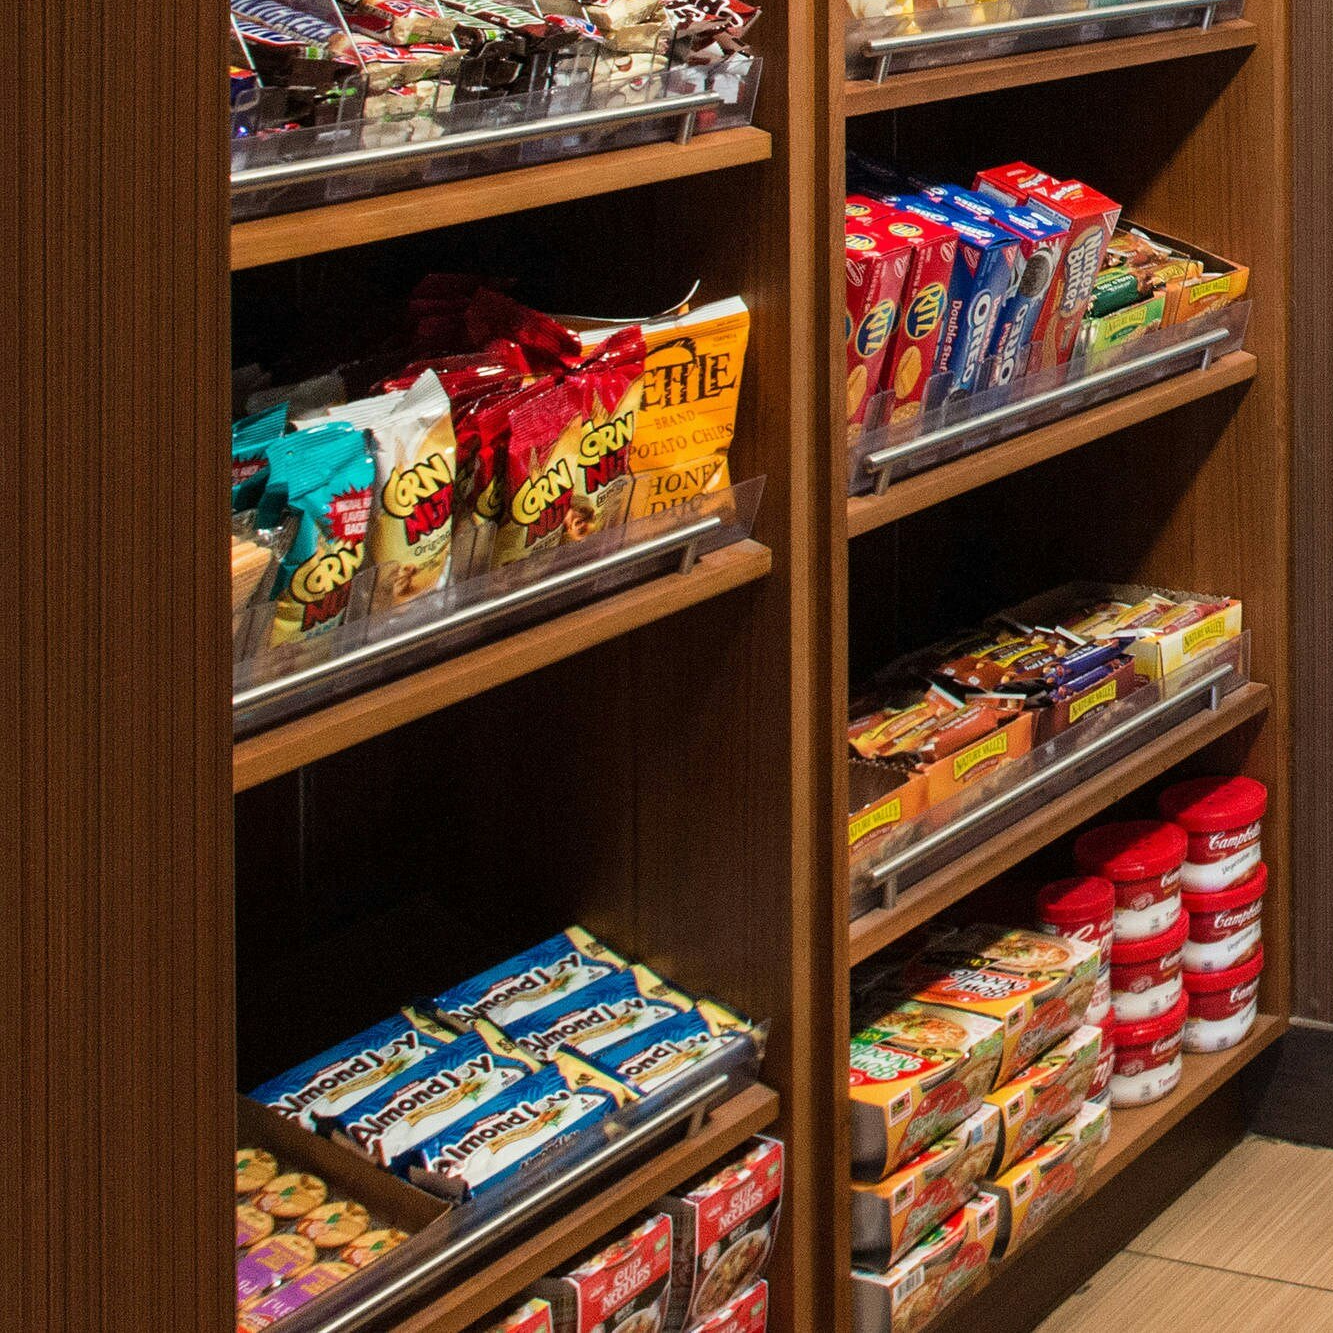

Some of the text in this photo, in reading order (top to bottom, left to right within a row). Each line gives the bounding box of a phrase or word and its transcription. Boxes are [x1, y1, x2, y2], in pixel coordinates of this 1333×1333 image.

[1062, 246, 1086, 313] Butter
[1080, 230, 1105, 300] Nutter
[914, 283, 946, 337] RITZ
[962, 294, 993, 384] OREO
[1003, 303, 1028, 382] OREO
[640, 350, 738, 413] ETTLE
[577, 410, 635, 467] CORN
[654, 409, 696, 431] BRAND
[691, 422, 735, 446] CHIPS
[382, 453, 451, 518] CORN
[512, 457, 575, 526] CORN
[848, 816, 872, 836] ATURE
[449, 974, 538, 1024] Almond
[515, 1006, 603, 1057] Almond
[625, 1047, 670, 1077] ond
[269, 1031, 419, 1119] Almond Joy
[348, 1054, 494, 1145] Almond Joy
[431, 1102, 531, 1178] Almond
